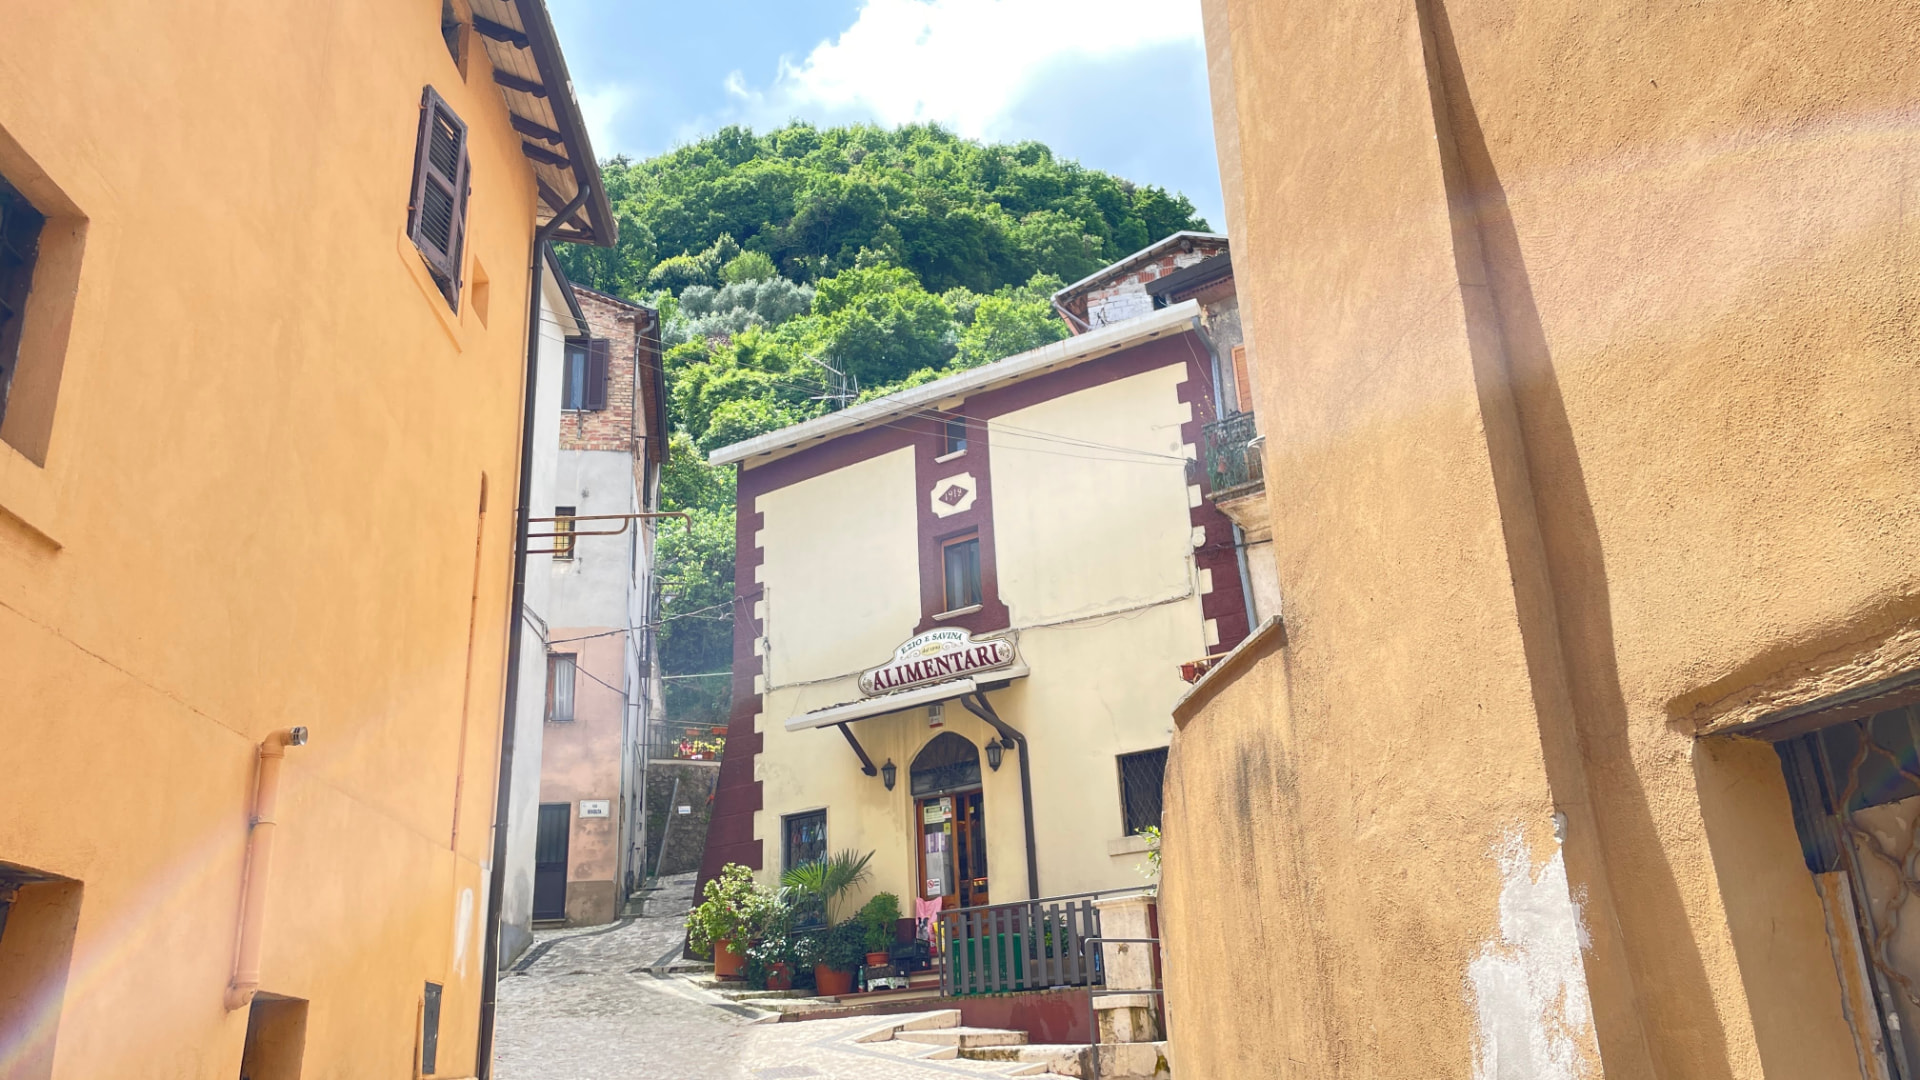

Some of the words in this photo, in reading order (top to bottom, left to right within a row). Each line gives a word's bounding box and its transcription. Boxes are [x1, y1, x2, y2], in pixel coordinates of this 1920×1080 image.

[901, 639, 922, 654] EZIO
[932, 631, 962, 641] SAVINA
[873, 643, 1002, 690] ALIMENTARI
